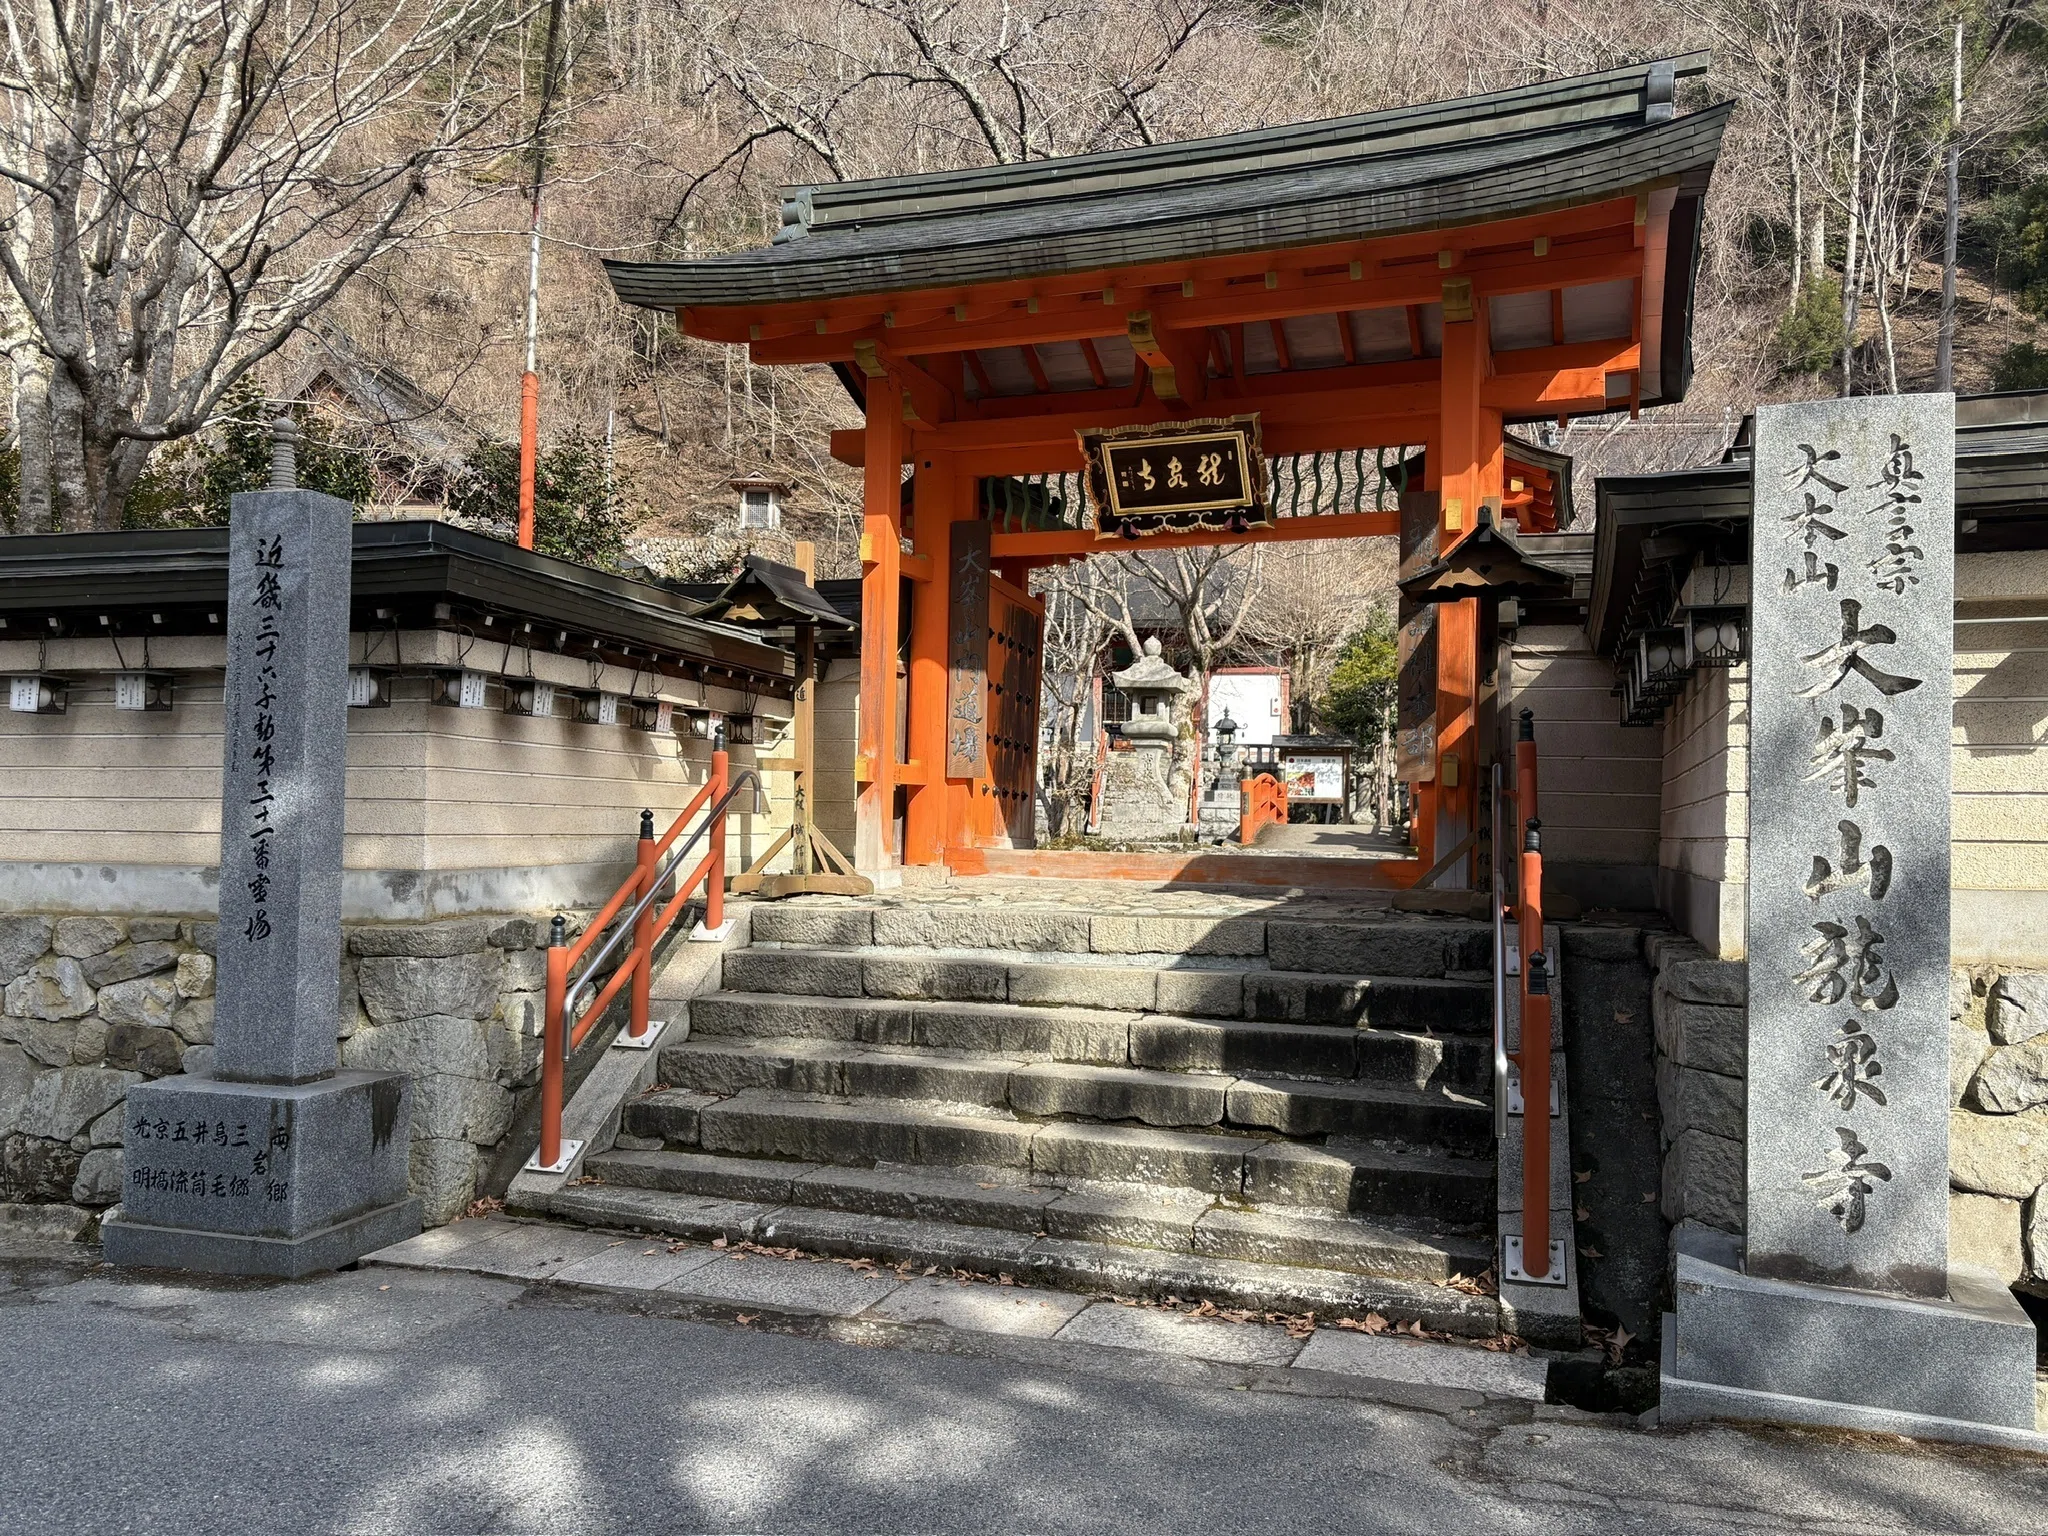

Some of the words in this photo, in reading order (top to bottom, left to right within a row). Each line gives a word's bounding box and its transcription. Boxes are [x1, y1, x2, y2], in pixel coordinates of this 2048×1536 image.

[1137, 452, 1226, 492] 龍泉寺
[1780, 443, 1850, 593] 大本山
[1866, 433, 1925, 596] 真言宗
[1792, 598, 1923, 1235] 大峯山龍泉寺
